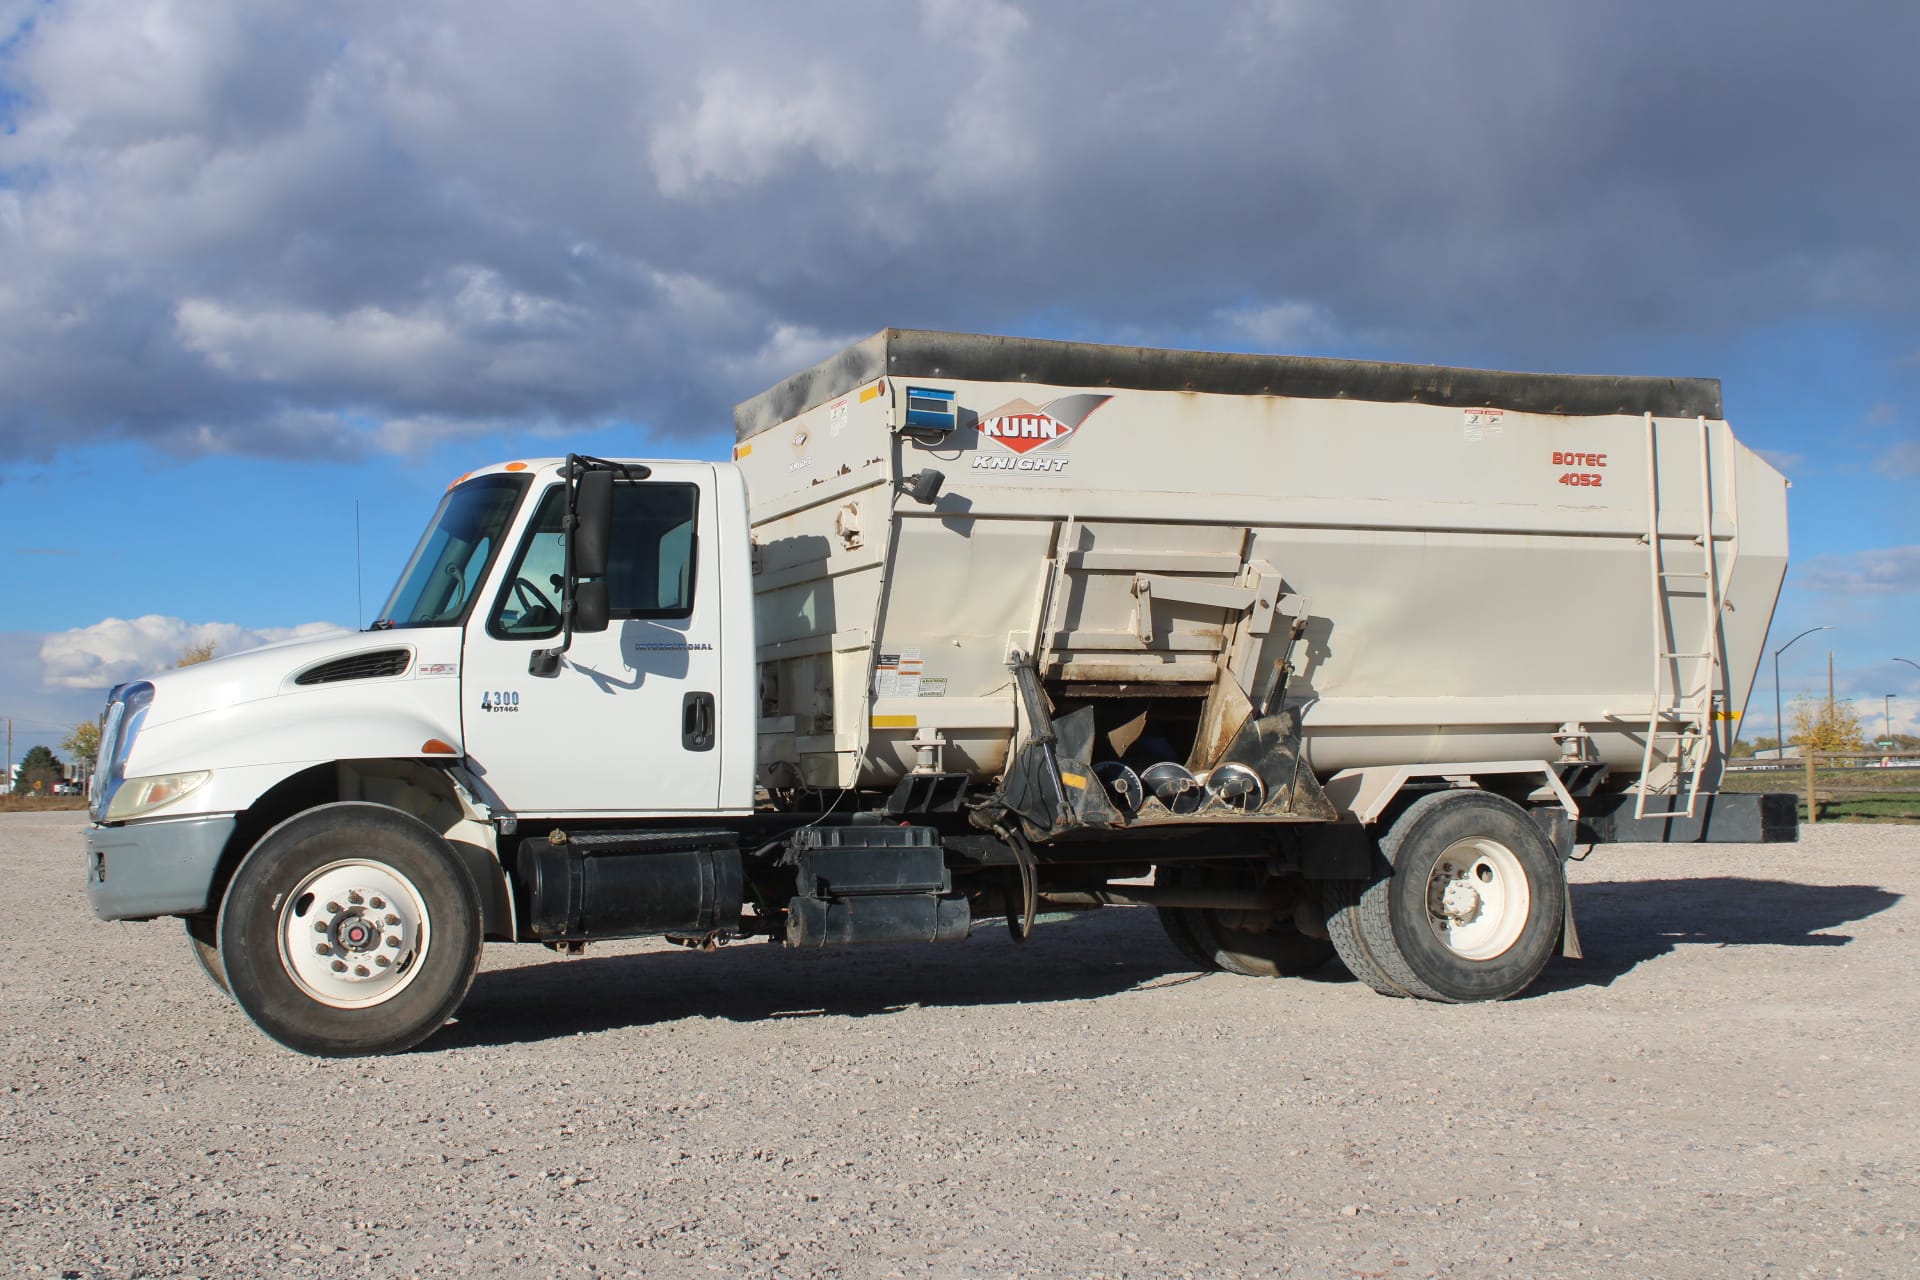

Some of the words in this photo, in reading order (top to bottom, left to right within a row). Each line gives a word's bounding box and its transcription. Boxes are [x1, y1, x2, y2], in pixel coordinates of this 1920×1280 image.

[984, 417, 1057, 439] KUHN
[972, 456, 1069, 472] KNIGHT
[1552, 451, 1608, 467] BOTEC
[1558, 473, 1602, 487] 4052
[481, 691, 520, 712] 4300
